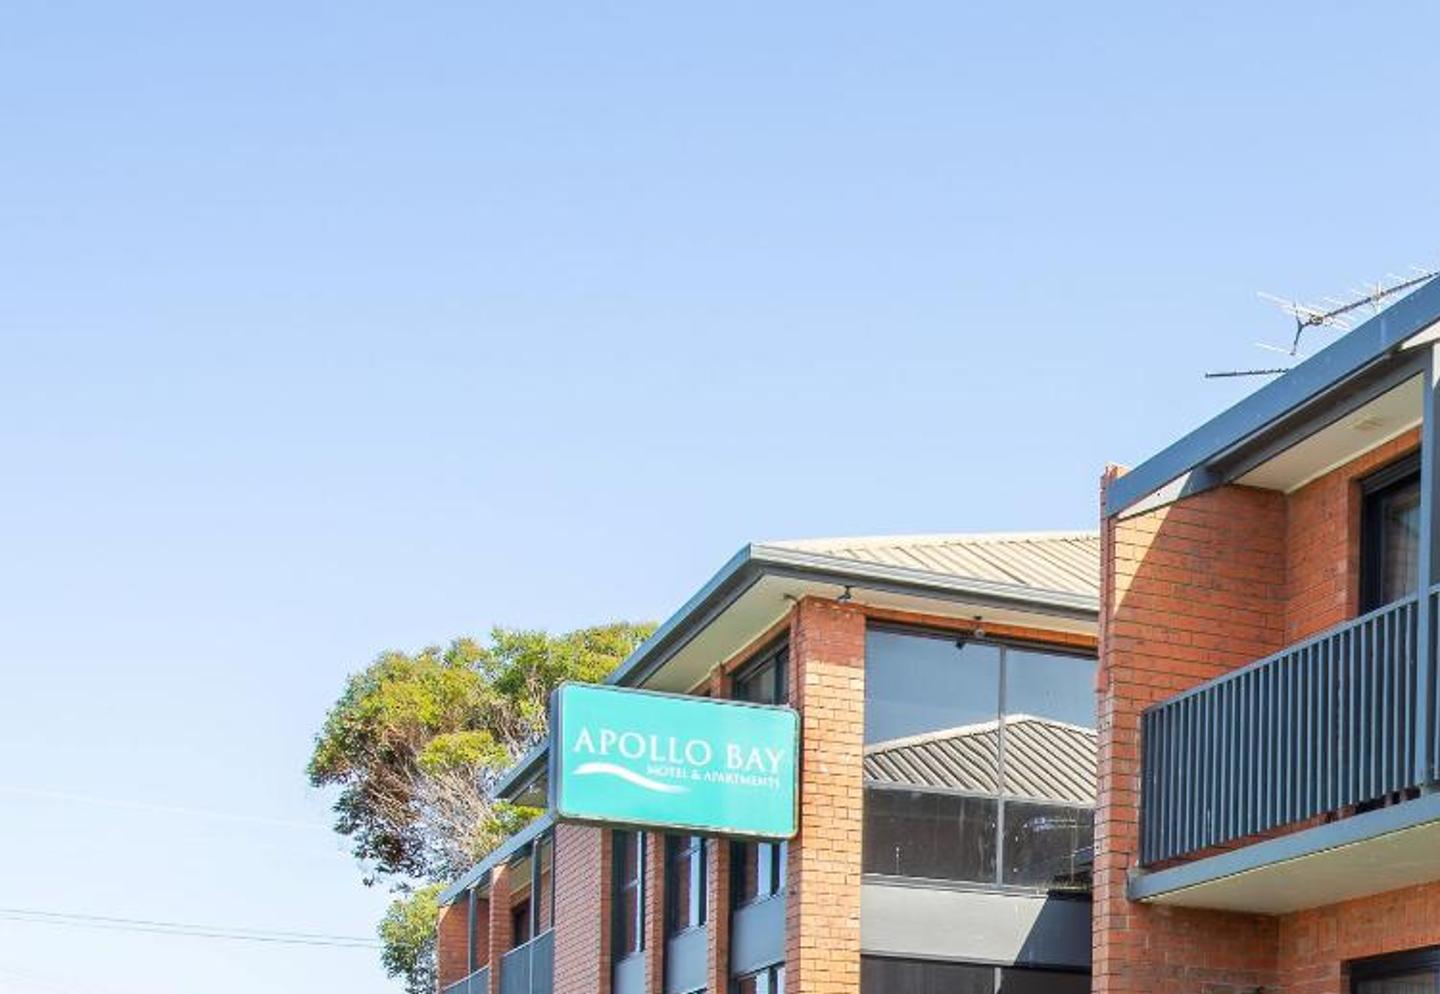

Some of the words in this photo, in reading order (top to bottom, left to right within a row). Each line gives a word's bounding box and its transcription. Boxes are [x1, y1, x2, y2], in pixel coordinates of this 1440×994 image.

[573, 727, 711, 766] APOLLO
[728, 742, 785, 773] BAY
[691, 769, 702, 780] &
[704, 771, 780, 788] APARTMENTS
